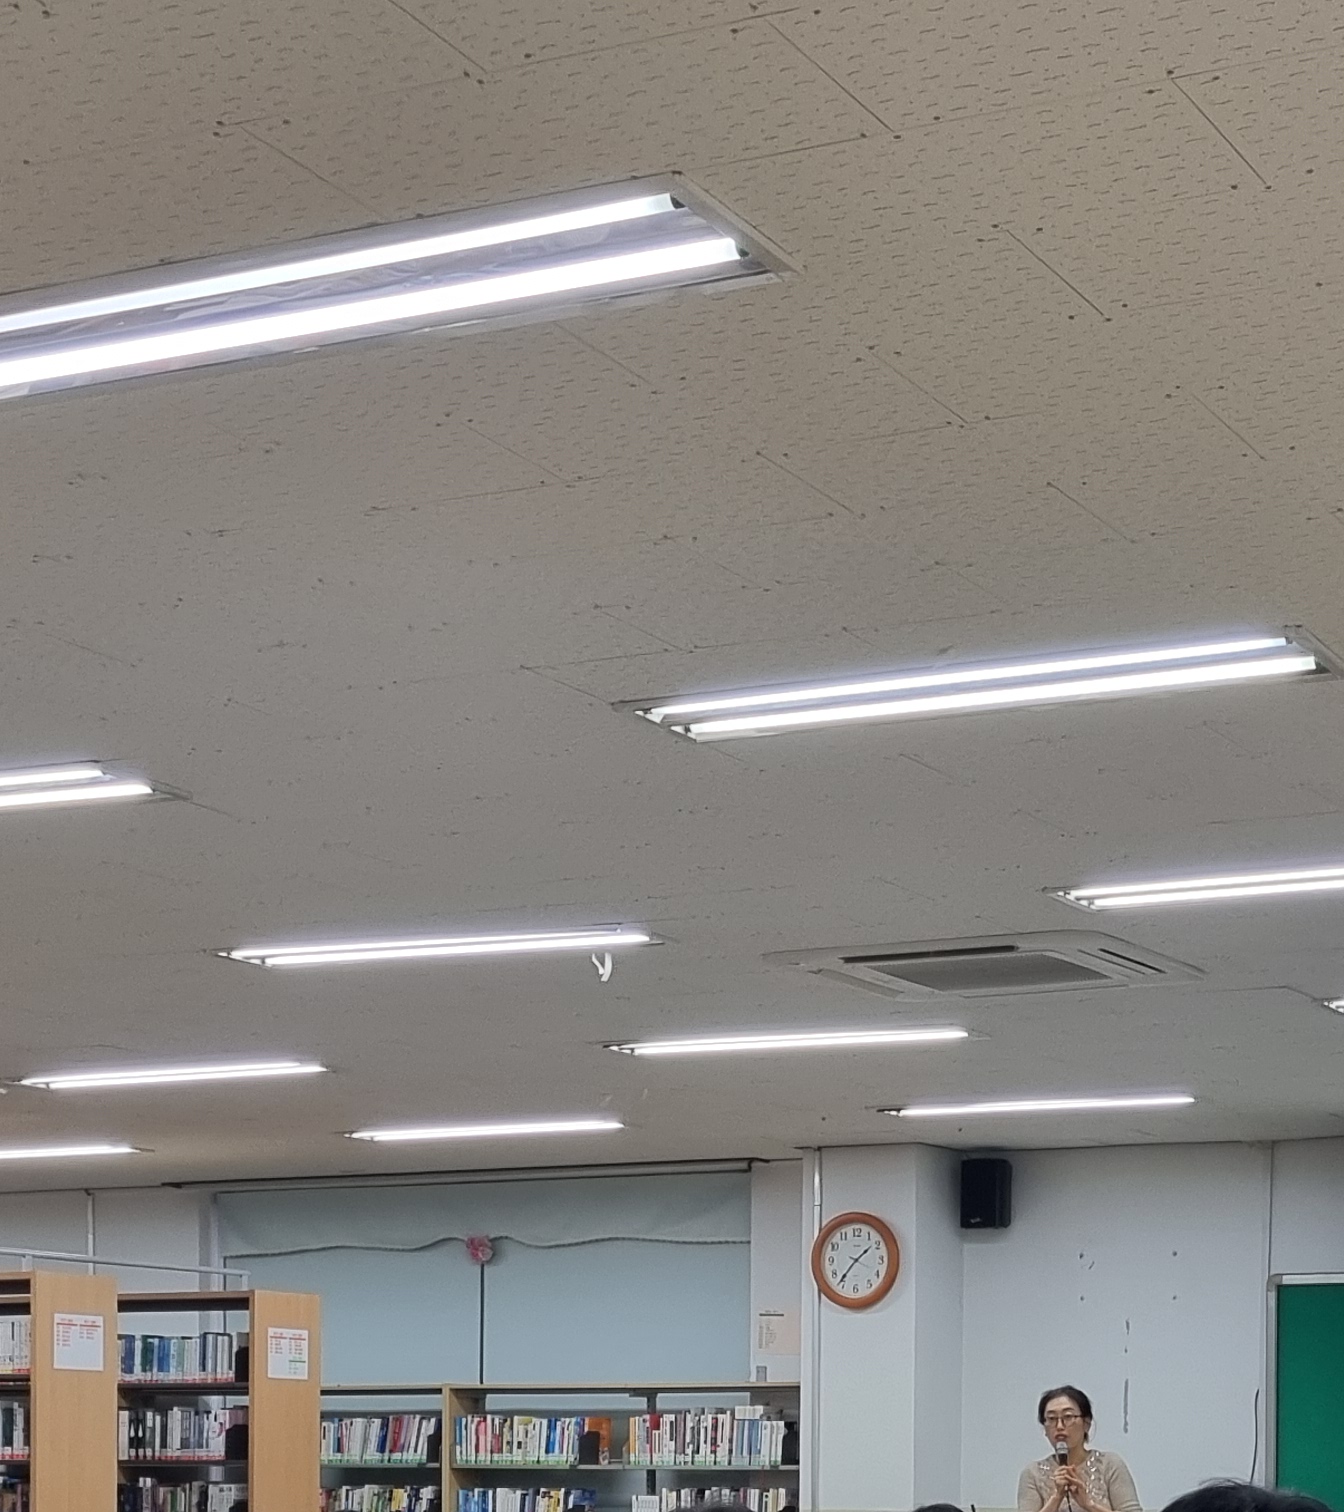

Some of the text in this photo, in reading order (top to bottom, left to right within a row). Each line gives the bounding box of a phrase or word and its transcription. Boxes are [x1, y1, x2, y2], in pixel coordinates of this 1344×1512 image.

[840, 1231, 847, 1240] 11
[852, 1228, 862, 1238] 12
[867, 1231, 870, 1240] 1
[830, 1242, 839, 1252] 10
[875, 1240, 880, 1250] 2
[828, 1256, 834, 1266] 9
[878, 1255, 884, 1265] 3
[832, 1269, 837, 1278] 8
[875, 1270, 879, 1279] 4
[866, 1279, 872, 1288] 5
[853, 1284, 859, 1293] 6
